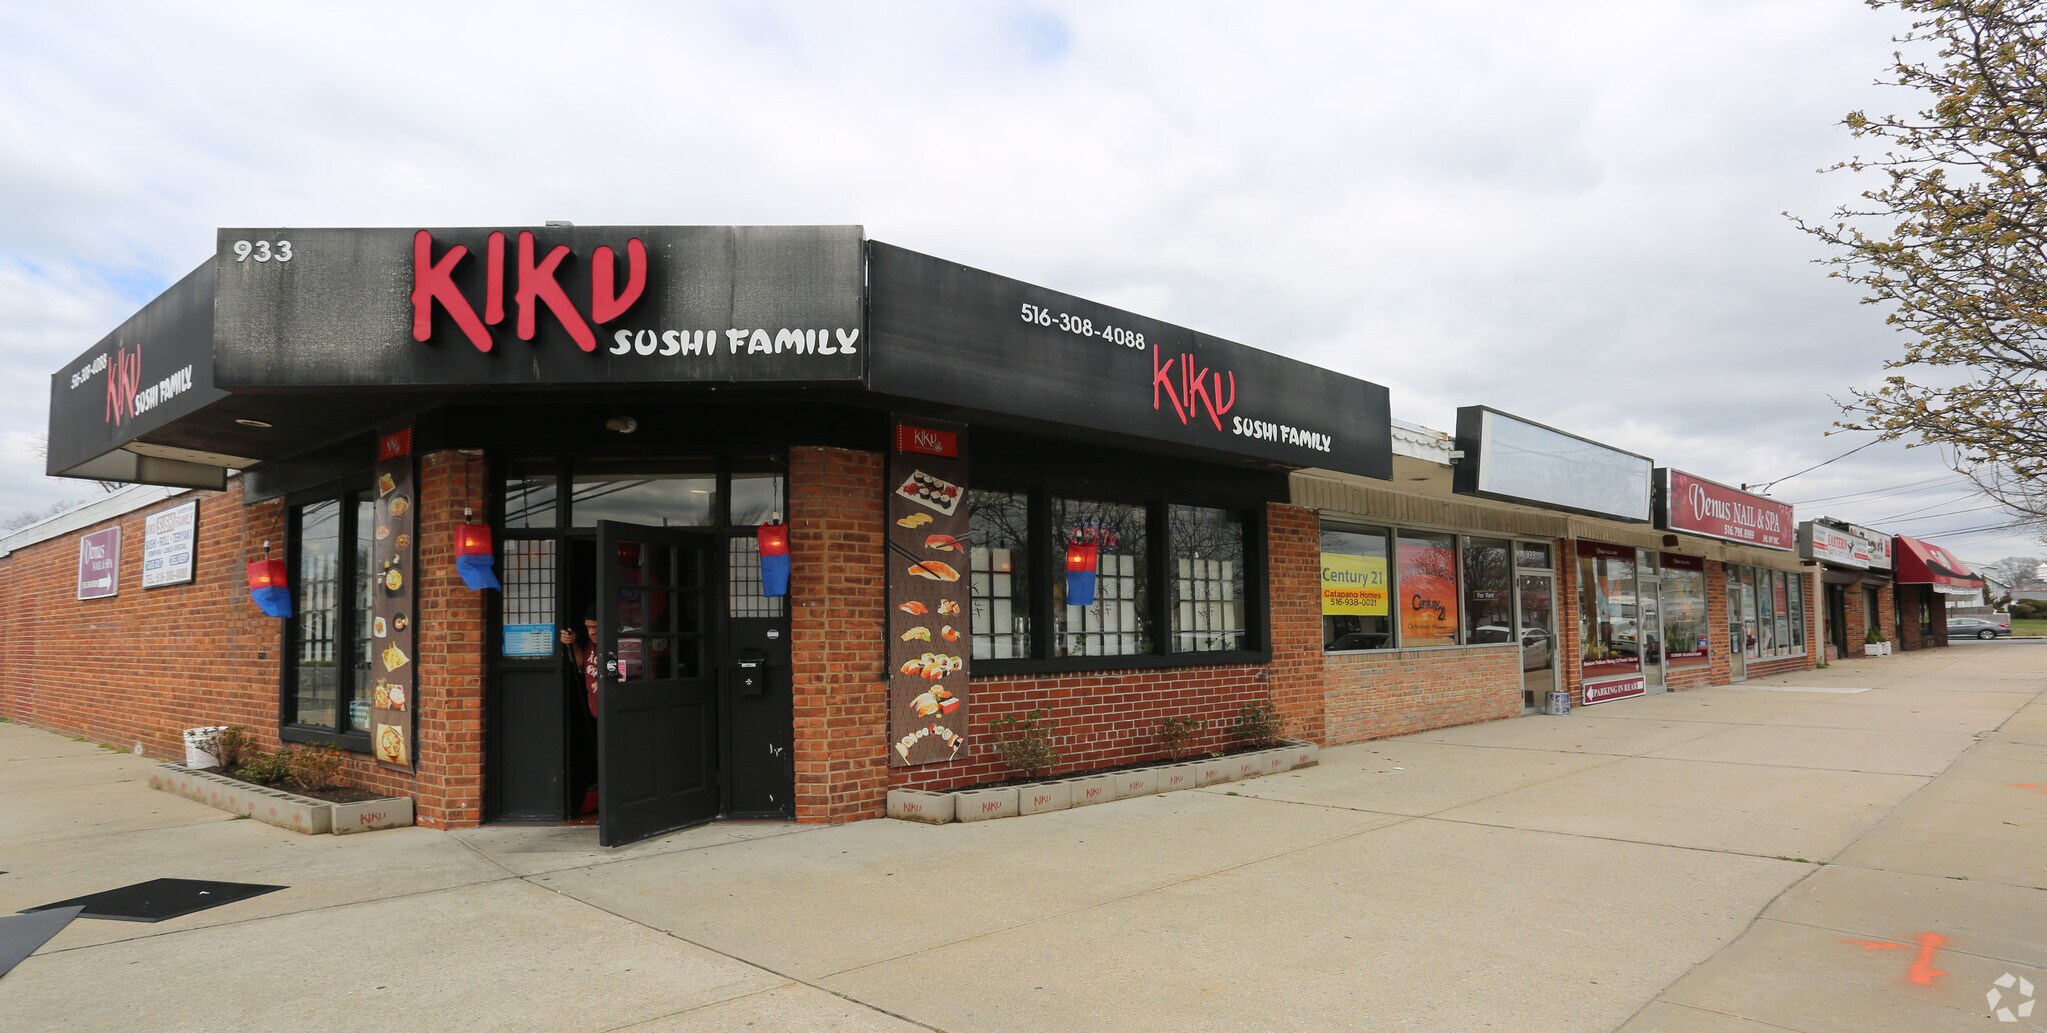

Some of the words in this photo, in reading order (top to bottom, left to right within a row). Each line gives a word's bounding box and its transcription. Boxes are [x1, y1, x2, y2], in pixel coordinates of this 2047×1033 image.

[233, 240, 293, 262] 933
[410, 229, 648, 353] KIKU
[1021, 303, 1146, 350] 516-308-4088
[609, 329, 717, 356] SUSHI
[725, 328, 859, 355] FAMILY
[105, 344, 141, 427] KIKU
[135, 384, 159, 416] SUSHI
[160, 364, 193, 403] FAMILY
[1153, 344, 1235, 432] KIKU
[914, 429, 937, 447] KIKU
[1232, 416, 1278, 442] SUSHI
[1281, 425, 1331, 452] FAMILY
[1689, 483, 1731, 521] Venus
[1733, 501, 1756, 528] NAIL
[1757, 509, 1764, 531] &
[1765, 510, 1780, 533] SPA
[158, 513, 176, 535] SUSHI
[176, 511, 193, 527] FAMILY
[1070, 526, 1118, 548] OPN
[84, 540, 105, 565] Venus
[1322, 567, 1368, 587] Century
[1371, 570, 1382, 585] 21
[1324, 589, 1358, 598] Catapano
[1360, 590, 1382, 599] Homes
[1330, 598, 1377, 606] 516-938-0021
[1411, 594, 1440, 611] Century
[1437, 606, 1446, 621] 21
[1593, 686, 1618, 697] PARKING
[1617, 684, 1624, 693] IN
[1624, 682, 1638, 692] REAR
[1086, 787, 1102, 798] KIKU
[1129, 781, 1144, 791] KIKU
[903, 802, 921, 814] KIKU
[982, 801, 1001, 813] KIKU
[1034, 794, 1051, 806] KIKU
[360, 811, 386, 825] KIKU
